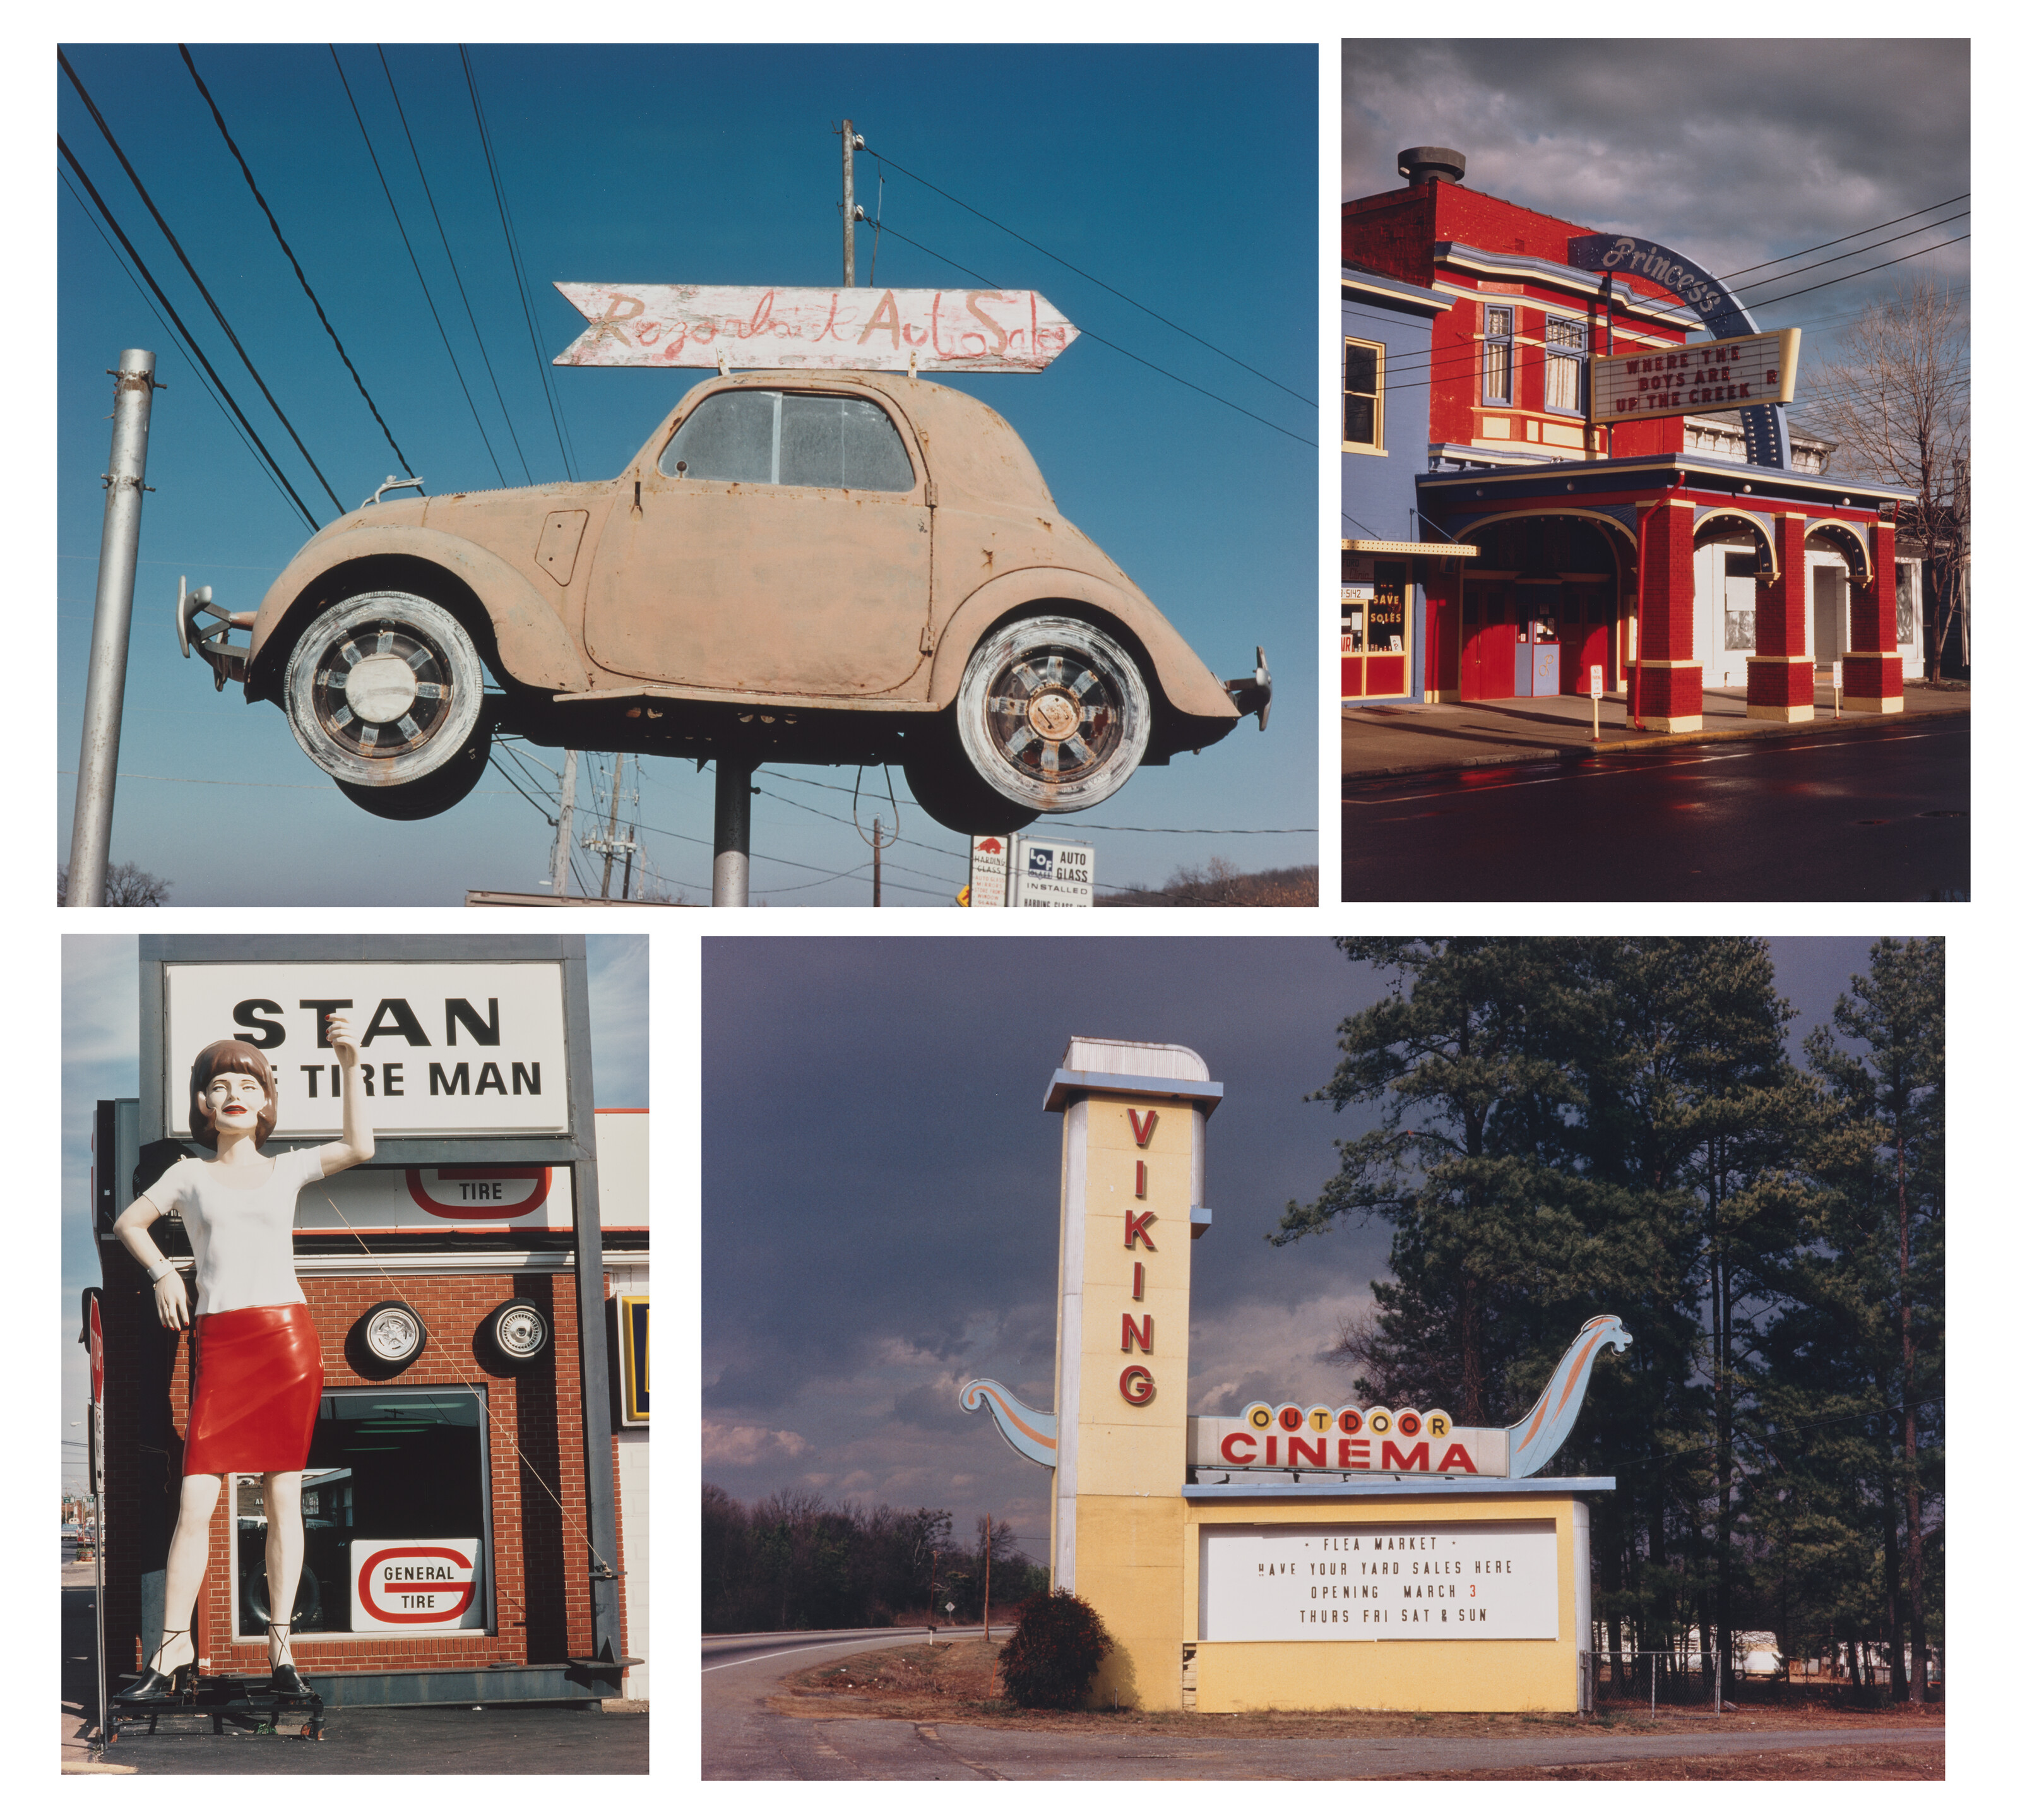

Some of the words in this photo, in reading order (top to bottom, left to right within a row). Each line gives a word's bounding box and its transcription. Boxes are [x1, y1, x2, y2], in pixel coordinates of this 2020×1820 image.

[1603, 238, 1721, 312] Princess
[1625, 352, 1689, 375] WHERE
[1701, 345, 1740, 364] THE
[1639, 372, 1685, 391] BOYS
[1694, 366, 1731, 384] ARE
[1766, 369, 1778, 385] R
[1615, 397, 1637, 413] UP
[1647, 391, 1680, 409] THE
[1689, 382, 1750, 403] CREEK
[1374, 594, 1399, 604] SAVE
[1370, 613, 1401, 623] SOLES
[975, 855, 1005, 866] HARDING
[1030, 848, 1052, 871] LOF
[1060, 851, 1086, 865] AUTO
[977, 865, 1001, 874] GLASS
[1057, 867, 1088, 883] GLASS
[1027, 883, 1088, 895] INSTALLED
[233, 998, 501, 1049] STAN
[300, 1062, 404, 1098] TIRE
[429, 1062, 542, 1096] MAN
[459, 1182, 502, 1200] TIRE
[1119, 1109, 1158, 1405] VIKING
[1251, 1405, 1446, 1436] OUTDOOR
[1220, 1432, 1479, 1474] CINEMA
[1324, 1538, 1360, 1551] FLEA
[1375, 1537, 1437, 1551] MARKET
[384, 1566, 454, 1581] GENERAL
[1310, 1562, 1347, 1576] YOUR
[1362, 1562, 1399, 1575] YARD
[1412, 1561, 1461, 1575] SALES
[1475, 1561, 1512, 1574] HERE
[1311, 1585, 1379, 1599] OPENING
[1403, 1585, 1456, 1598] MARCH
[1470, 1585, 1476, 1597] 3
[401, 1595, 434, 1609] TIRE
[1300, 1610, 1349, 1623] THURS
[1363, 1610, 1387, 1623] FRI
[1401, 1609, 1430, 1622] SAT
[1441, 1609, 1447, 1622] &
[1459, 1609, 1487, 1622] SUN
